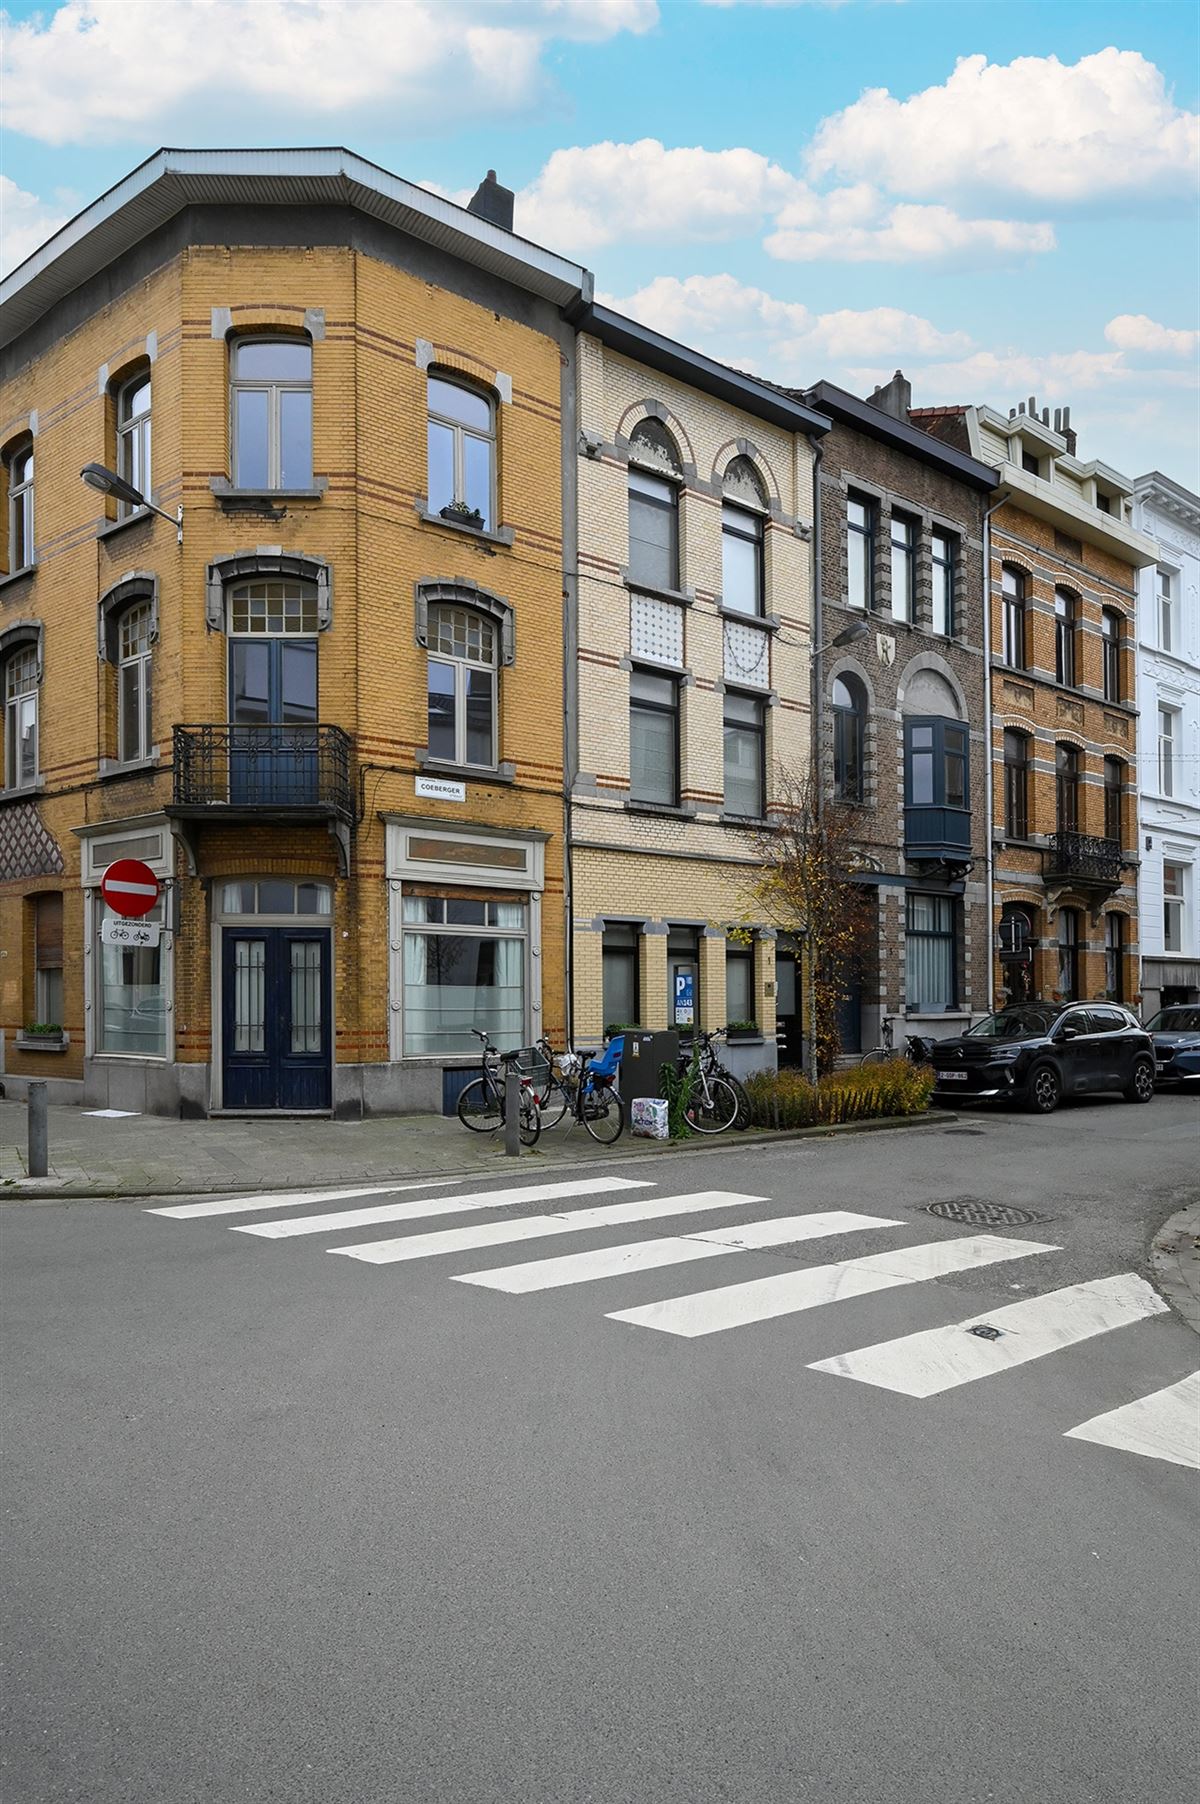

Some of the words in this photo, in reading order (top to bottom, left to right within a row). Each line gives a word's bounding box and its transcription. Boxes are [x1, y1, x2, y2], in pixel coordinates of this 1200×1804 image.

[421, 784, 460, 794] COEBERGER
[113, 920, 152, 928] UITGEZONDERD
[676, 976, 686, 996] P
